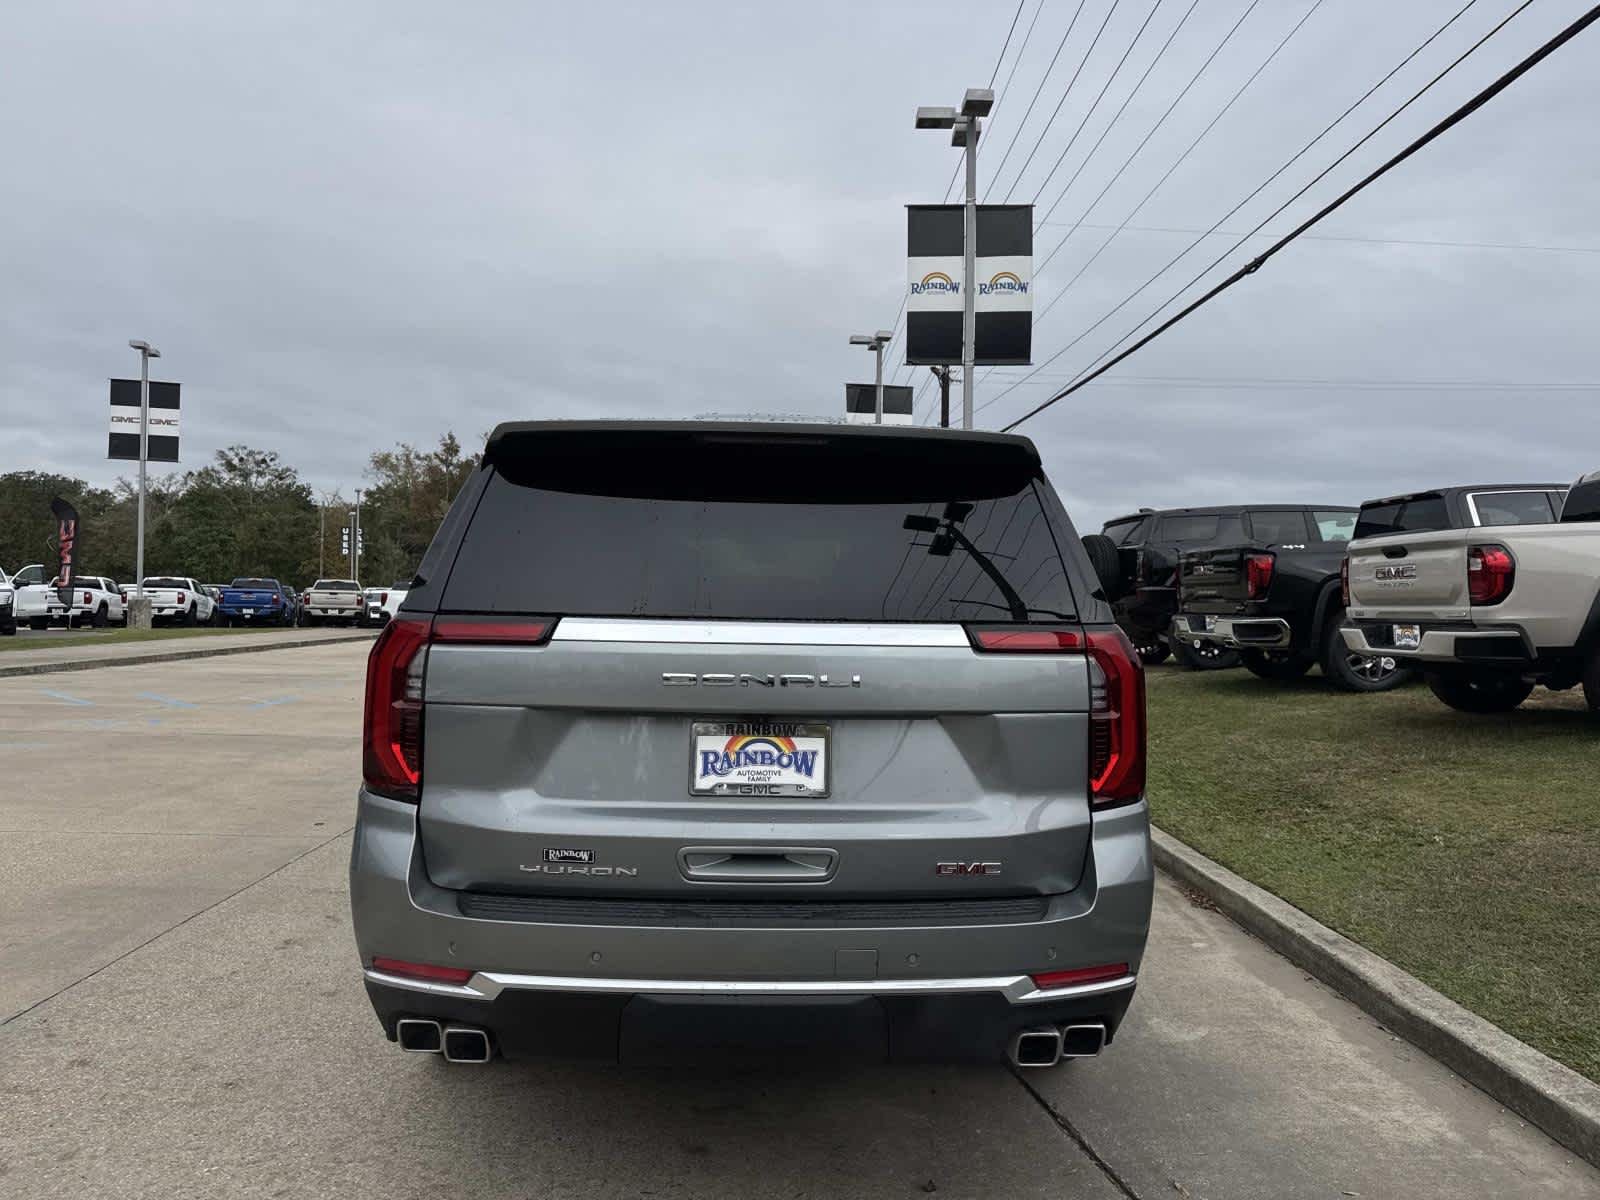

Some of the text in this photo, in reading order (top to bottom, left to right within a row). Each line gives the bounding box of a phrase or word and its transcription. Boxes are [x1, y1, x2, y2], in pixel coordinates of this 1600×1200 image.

[911, 282, 960, 295] RAINBOW
[979, 282, 1029, 295] RAINBOW
[1375, 566, 1417, 580] GMC
[662, 672, 861, 688] DENALI
[725, 723, 797, 736] RAINBOW
[700, 749, 819, 778] RAINBOW
[739, 784, 781, 794] GMC
[548, 849, 591, 862] RAINBOW
[519, 864, 637, 876] YUKON
[936, 862, 1002, 876] GMC
